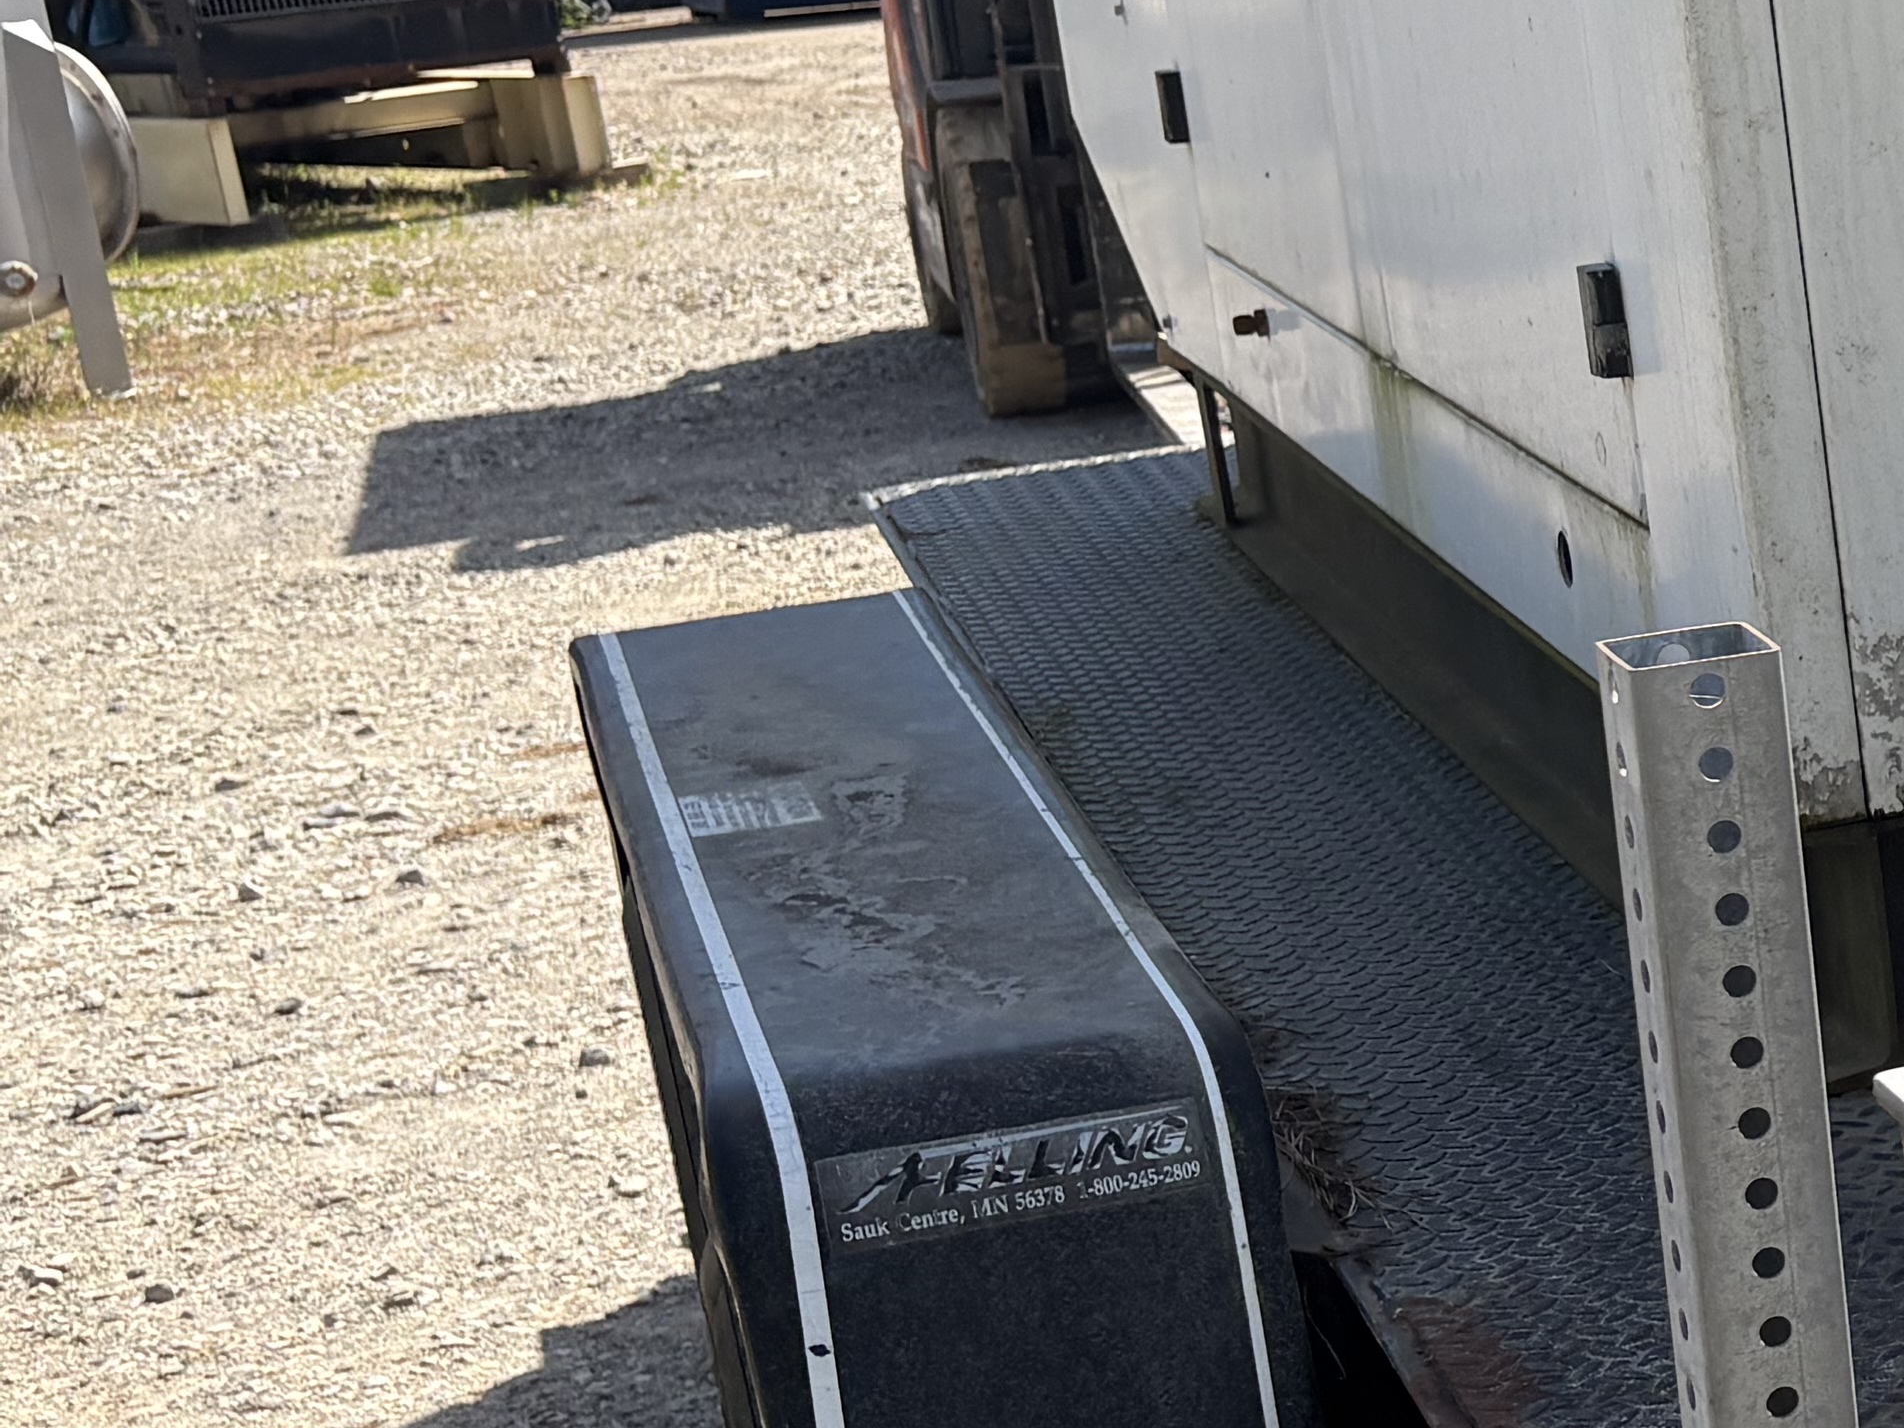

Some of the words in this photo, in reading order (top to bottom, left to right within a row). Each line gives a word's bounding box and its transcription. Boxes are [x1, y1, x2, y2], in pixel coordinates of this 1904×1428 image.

[840, 1217, 890, 1244] Sauk
[897, 1202, 966, 1233] Centre,
[971, 1193, 1010, 1220] MN
[1014, 1184, 1066, 1213] 56378
[1076, 1159, 1202, 1200] 1-800-245-2809
